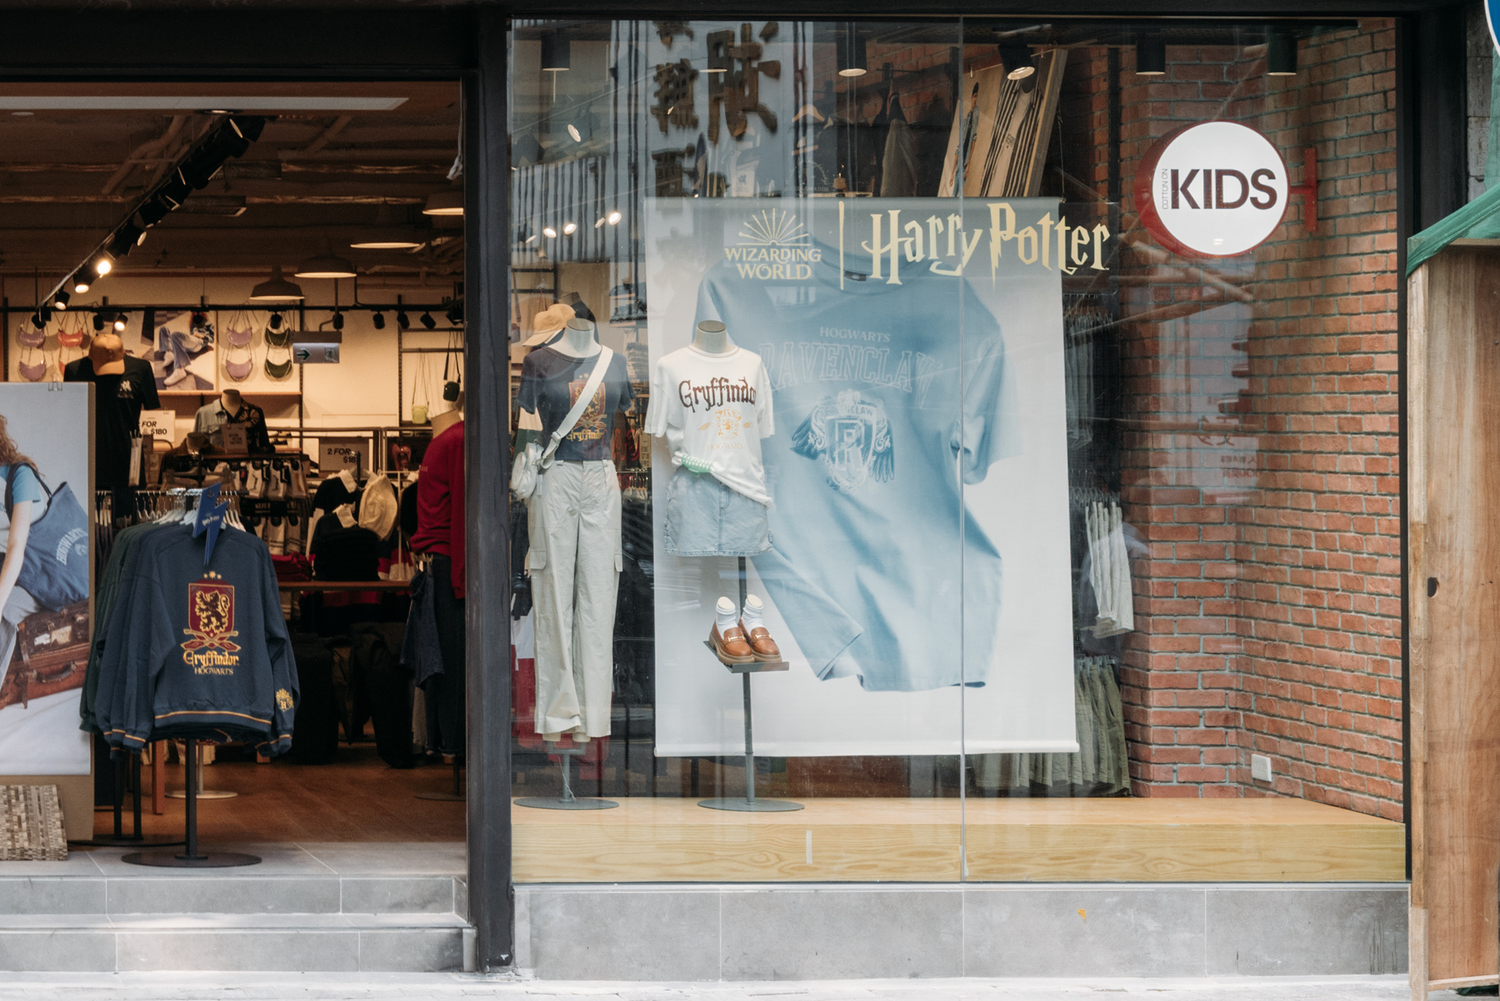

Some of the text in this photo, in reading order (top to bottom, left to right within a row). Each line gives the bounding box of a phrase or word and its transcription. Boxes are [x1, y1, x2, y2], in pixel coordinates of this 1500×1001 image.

[1162, 168, 1169, 179] ON
[1171, 168, 1277, 210] KIDS
[861, 202, 1110, 289] Harry Potter
[724, 248, 822, 263] WIZARDING
[736, 263, 812, 280] WORLD
[820, 326, 891, 343] HOGWARTS
[758, 341, 943, 409] RAVENCLAW
[678, 376, 757, 413] Gryffindo
[183, 650, 240, 667] Gryffindor
[194, 667, 234, 675] HOGWARTS
